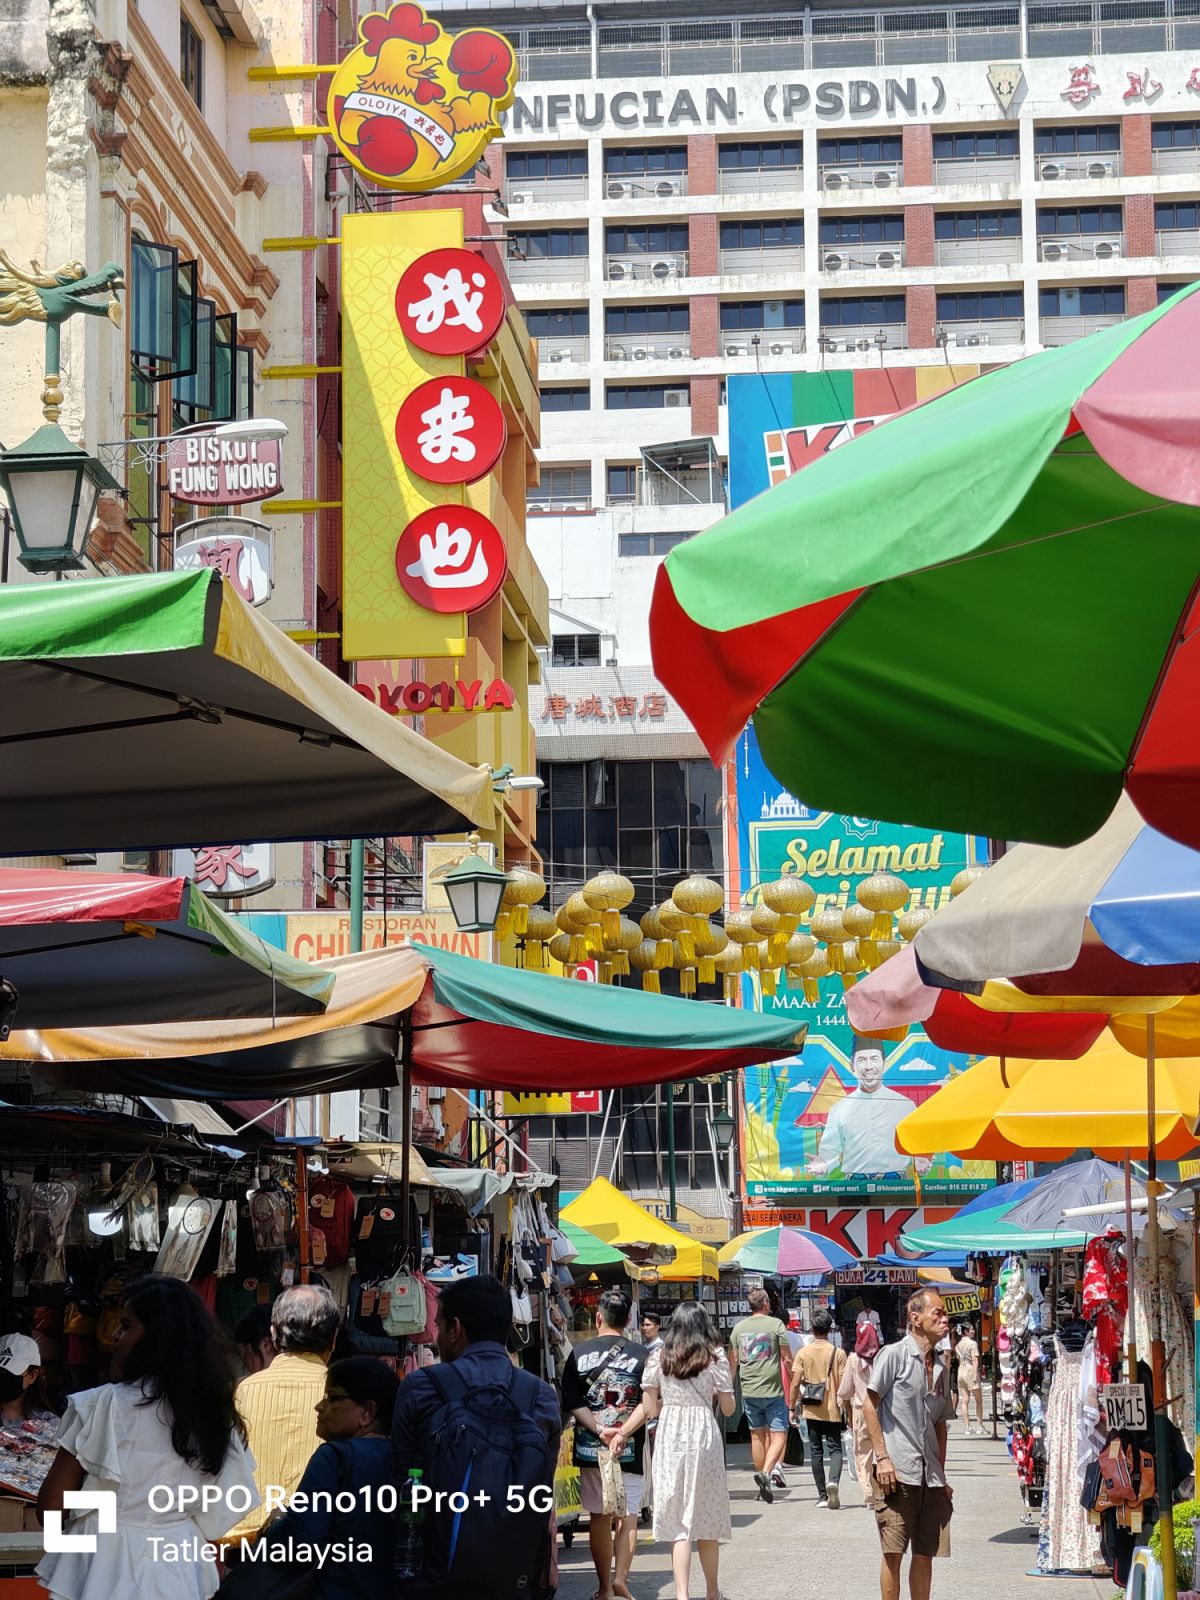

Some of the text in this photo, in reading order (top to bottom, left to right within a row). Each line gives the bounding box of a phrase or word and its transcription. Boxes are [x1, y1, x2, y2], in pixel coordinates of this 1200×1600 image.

[358, 97, 407, 118] OLOIYA
[170, 463, 277, 494] FUNG WONG
[541, 693, 667, 720] 唐城酒店
[780, 833, 944, 878] Selamat
[339, 918, 437, 931] RSTORAN
[816, 1014, 849, 1026] 1444
[760, 1212, 803, 1222] SERBANEKA
[809, 1208, 919, 1258] KK
[838, 1269, 915, 1283] BUKA 24 JAM
[1106, 1398, 1145, 1427] RM15
